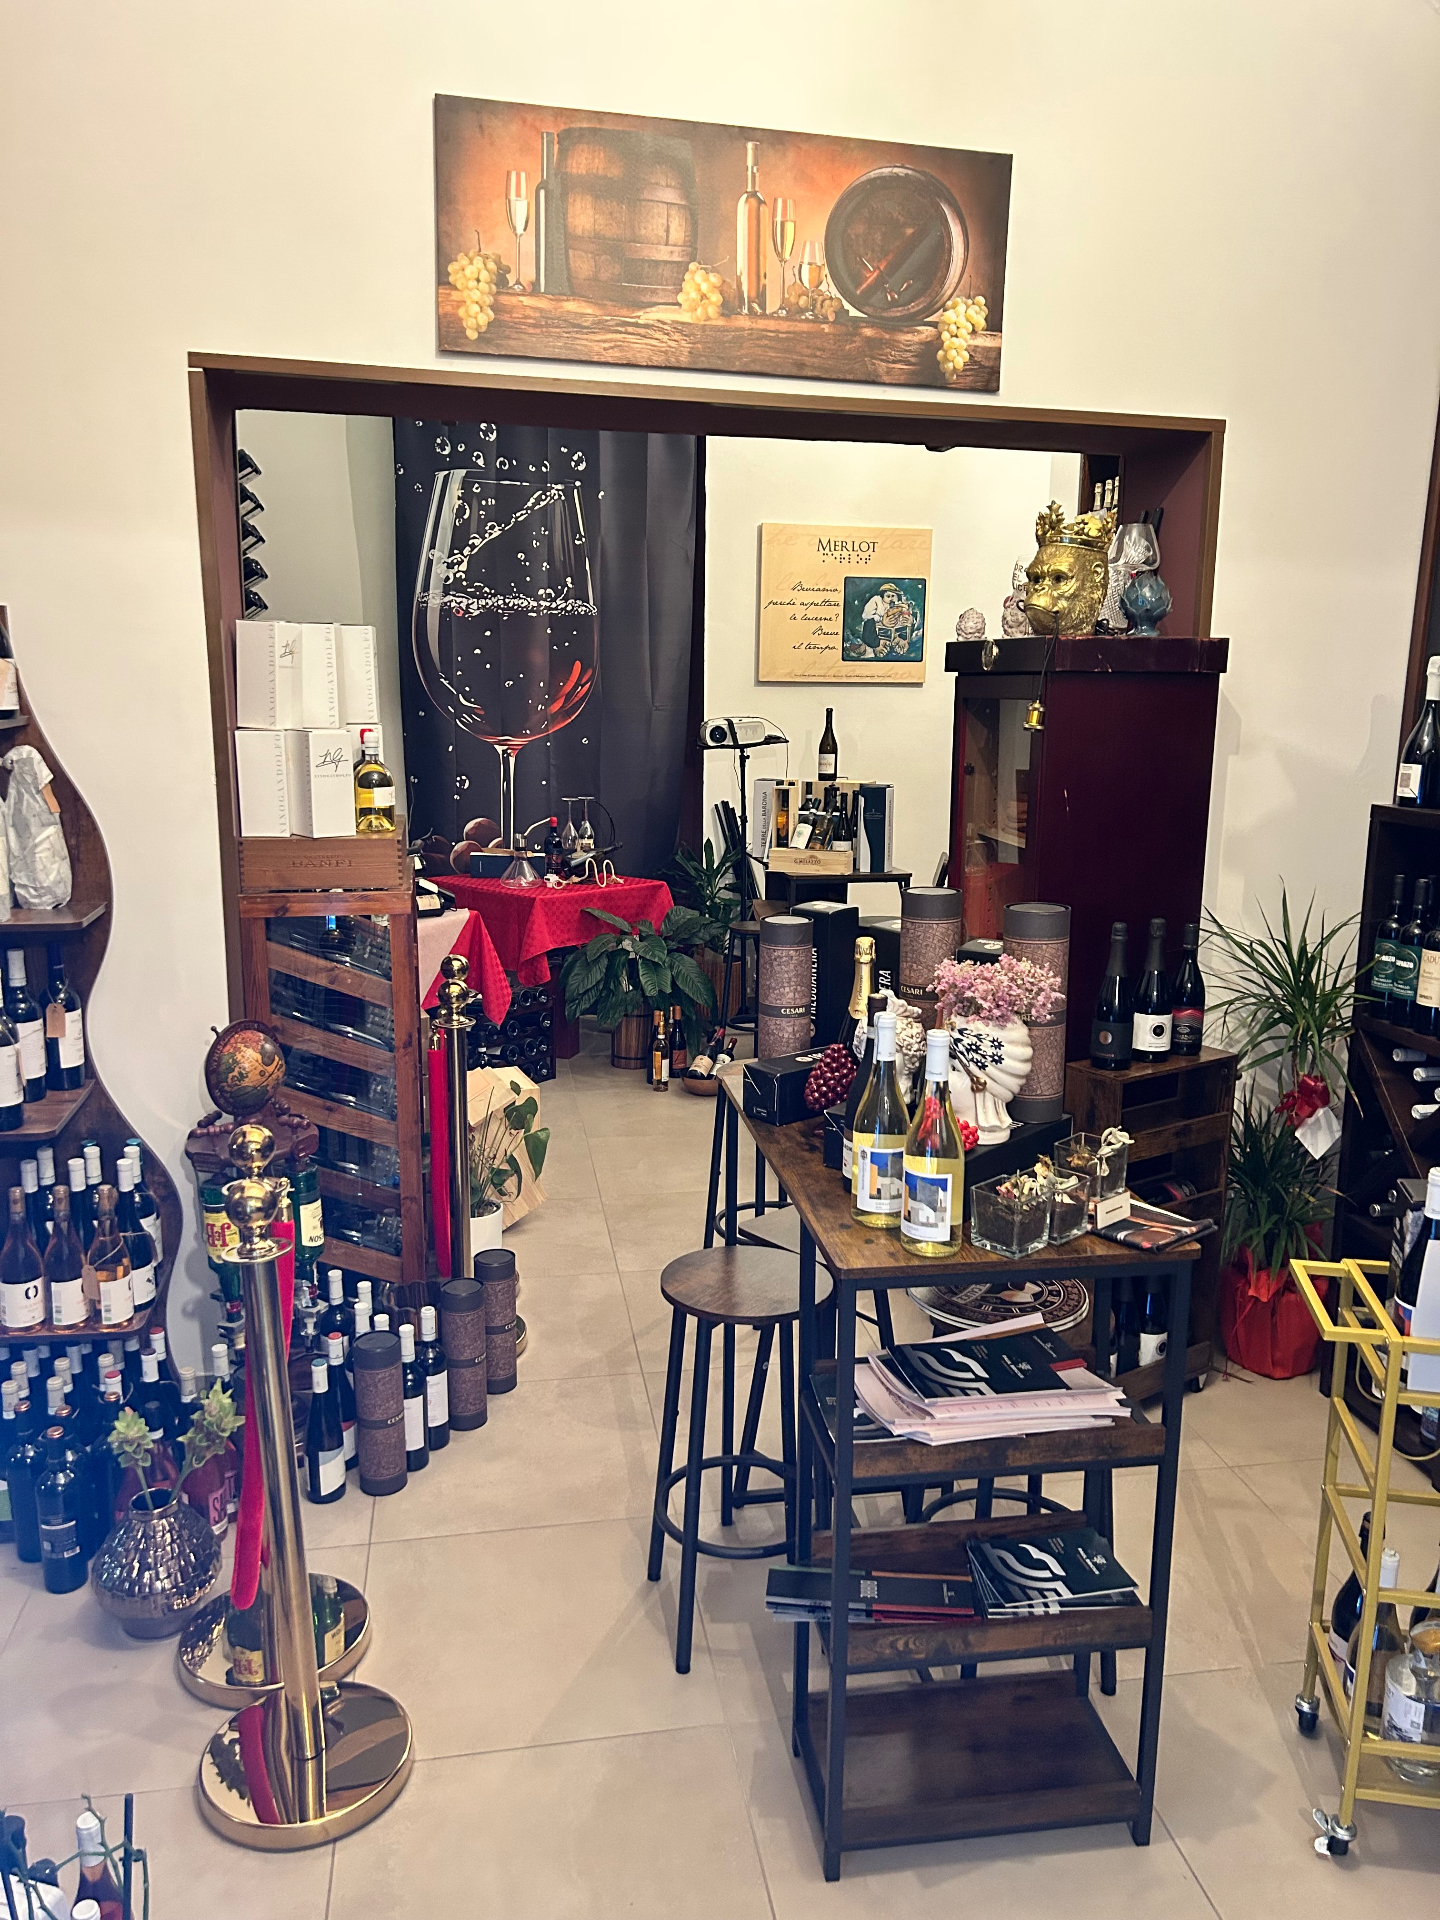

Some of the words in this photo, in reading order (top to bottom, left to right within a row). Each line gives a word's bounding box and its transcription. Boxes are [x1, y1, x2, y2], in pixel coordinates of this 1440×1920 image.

[799, 598, 841, 611] aspettare
[900, 985, 923, 996] CESARI
[781, 1006, 806, 1016] CESARI
